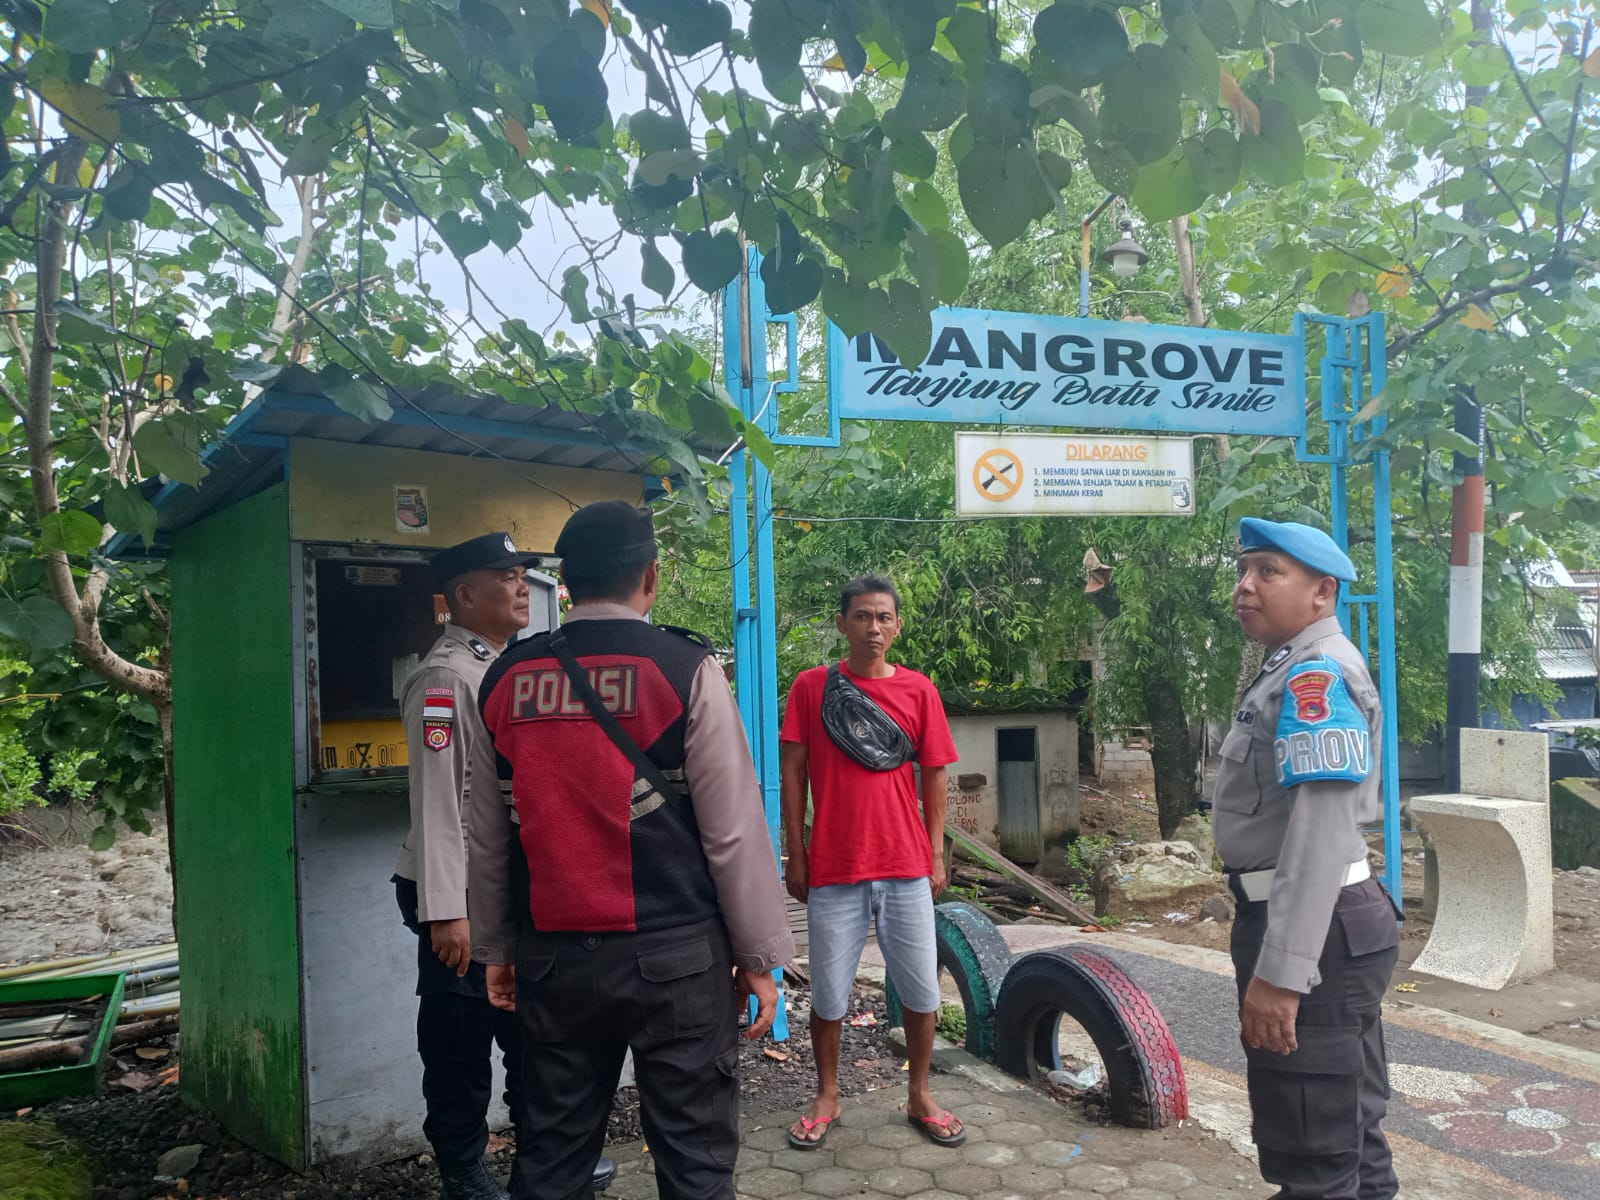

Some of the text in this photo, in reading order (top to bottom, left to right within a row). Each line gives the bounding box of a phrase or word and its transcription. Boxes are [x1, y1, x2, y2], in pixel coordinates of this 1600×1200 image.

[864, 365, 1276, 413] Tanjung Batu Smile
[1066, 444, 1148, 460] DILARANG
[1034, 467, 1177, 477] 1. MEMBURU SATWA LIAR DI KAWASAN INI
[1033, 478, 1041, 486] 2.
[1043, 478, 1082, 487] MEMBAWA
[1083, 478, 1112, 487] SENJATA
[1114, 479, 1137, 487] TAJAM
[1034, 489, 1104, 497] 3. MINUMAN KERAS
